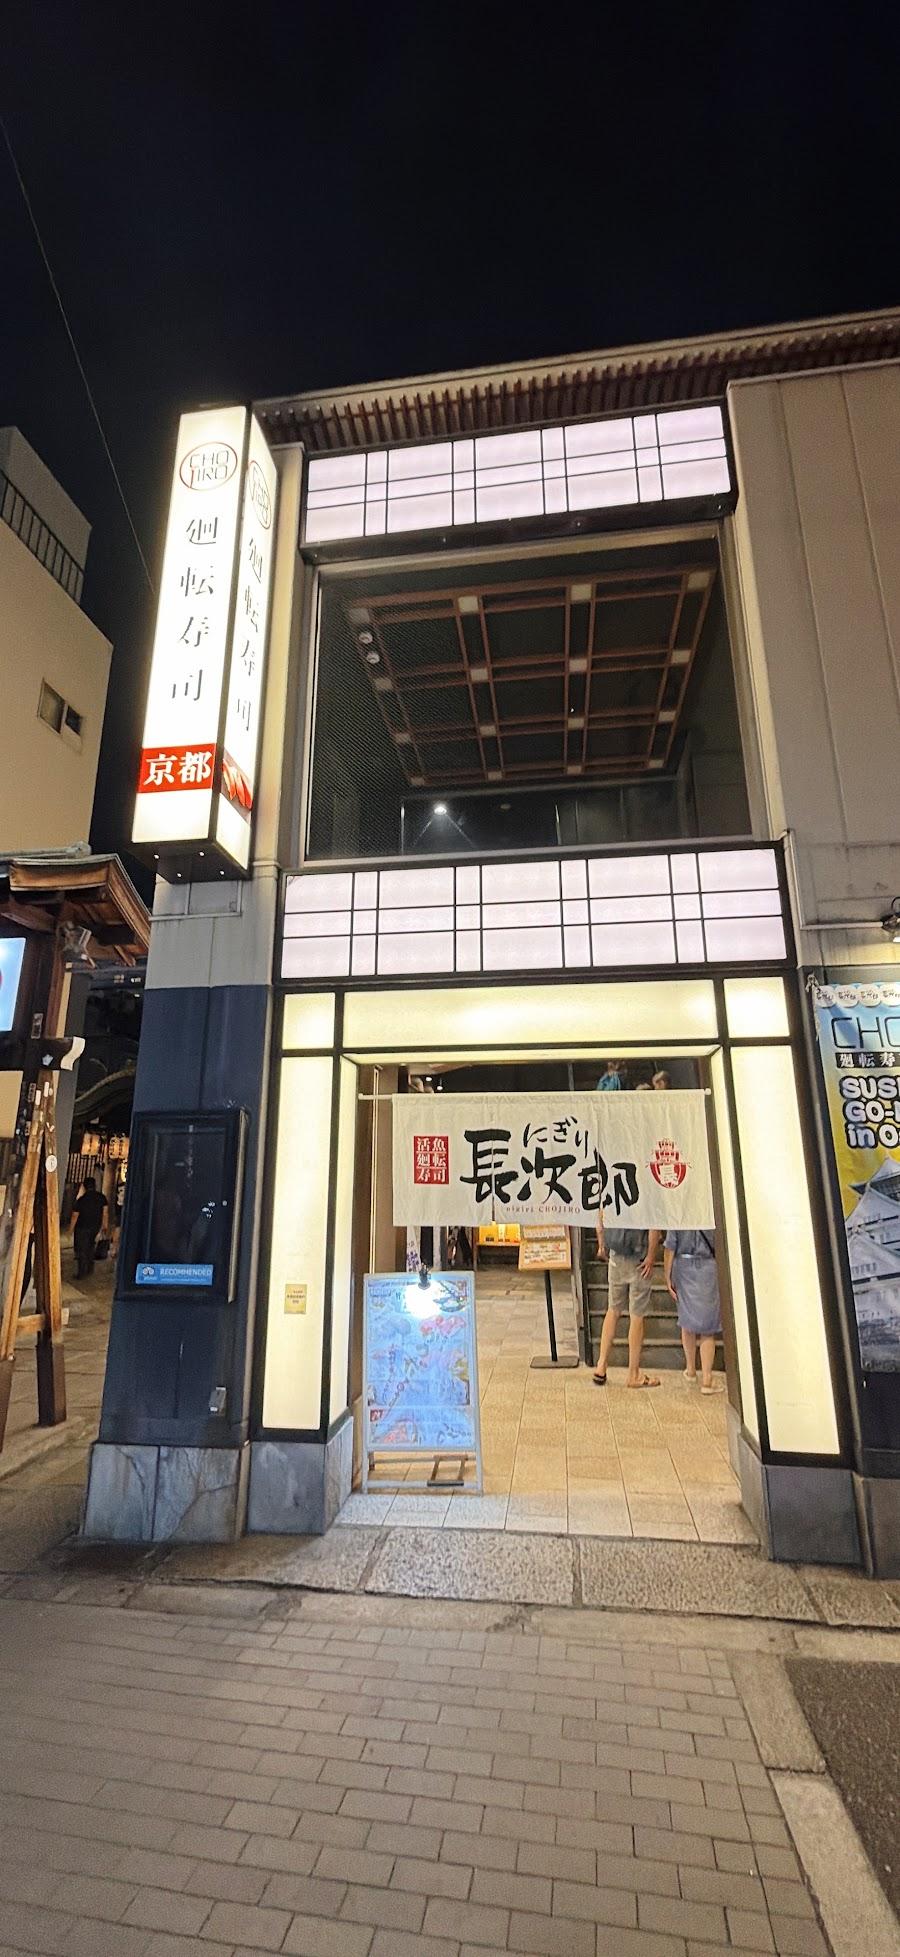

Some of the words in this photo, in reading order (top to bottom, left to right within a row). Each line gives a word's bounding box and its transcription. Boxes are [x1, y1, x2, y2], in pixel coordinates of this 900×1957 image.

[190, 451, 229, 467] CHO
[143, 751, 213, 786] 京都
[523, 1116, 589, 1159] にぎり
[847, 1123, 876, 1148] in
[878, 1123, 900, 1148] O
[416, 1137, 446, 1151] 活魚
[416, 1152, 447, 1167] 廻転
[416, 1168, 447, 1183] 寿司
[459, 1128, 640, 1216] 長次郎
[538, 1205, 581, 1214] CHOJIRO
[160, 1267, 213, 1277] RECOMMENDED
